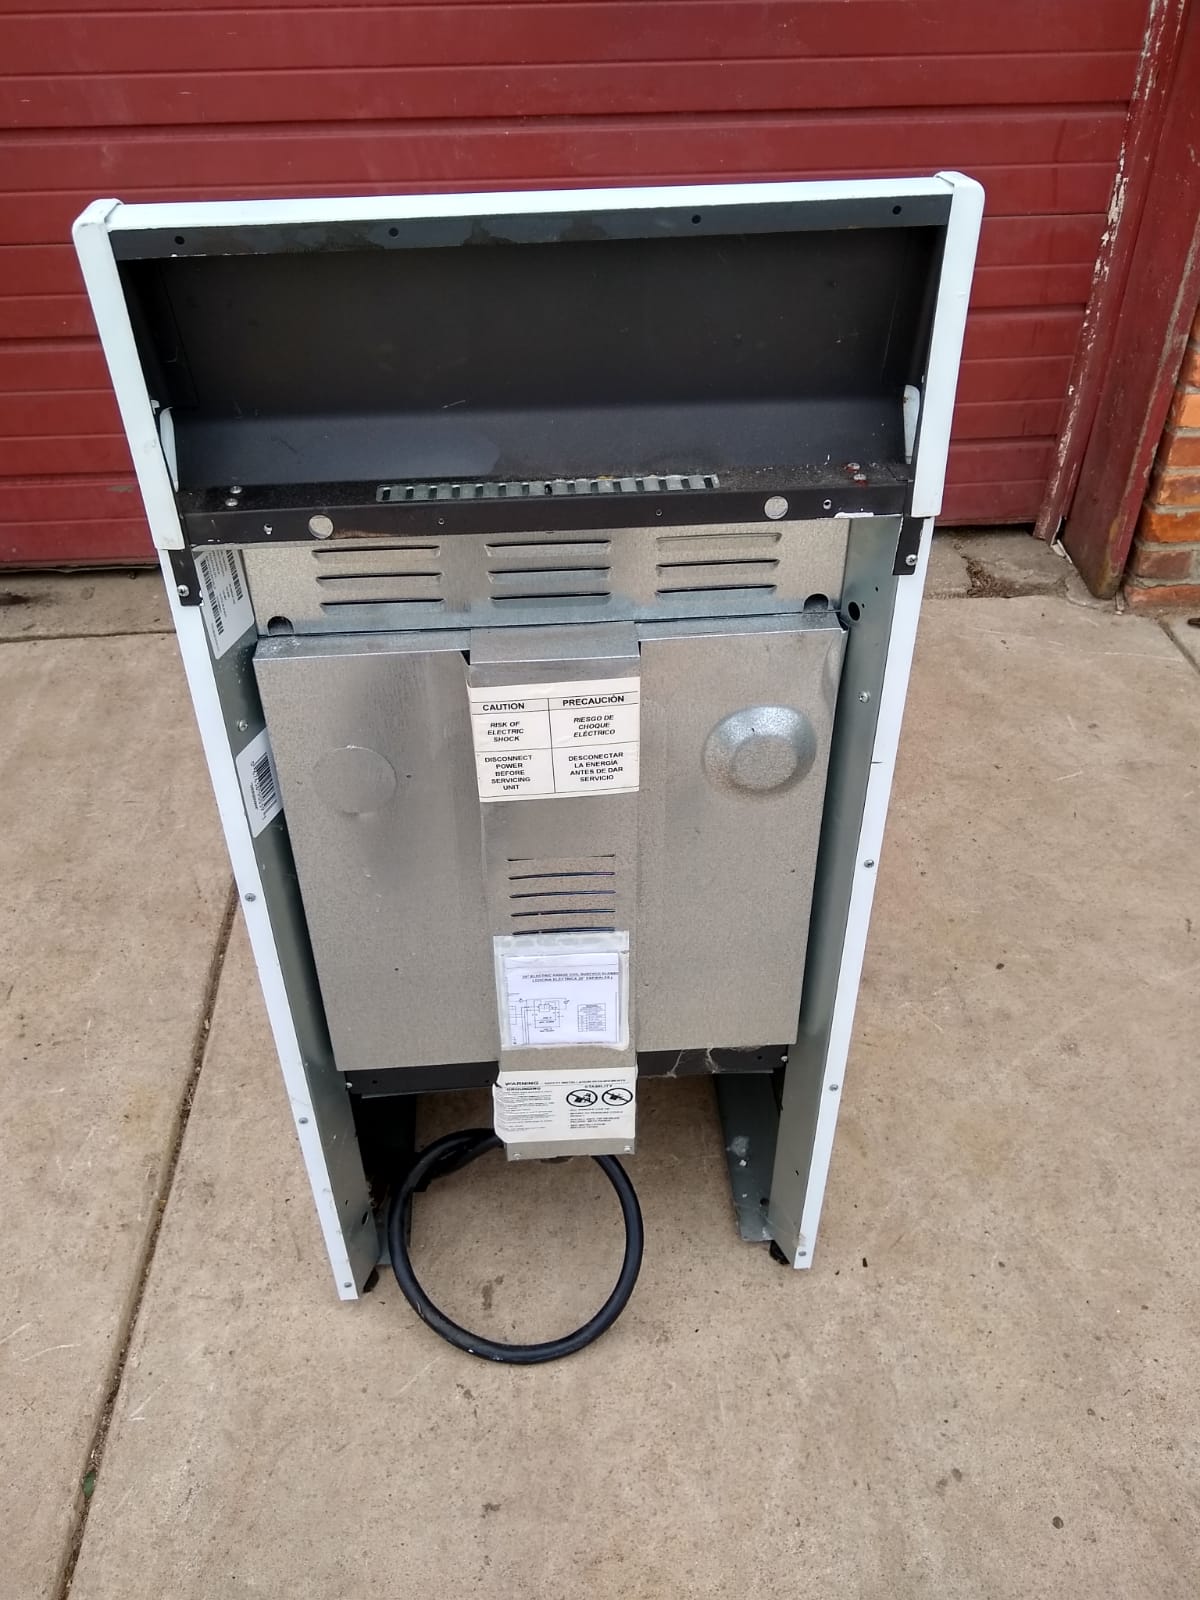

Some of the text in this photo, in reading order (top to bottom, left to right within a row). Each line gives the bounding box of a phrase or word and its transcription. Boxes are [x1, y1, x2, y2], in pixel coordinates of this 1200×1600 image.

[562, 695, 625, 707] PRECAUCIÓN
[482, 702, 525, 711] CAUTION
[578, 722, 610, 730] CHOQUE
[484, 754, 533, 762] DISCONNECT
[568, 752, 624, 762] DESCONECTAR
[495, 769, 525, 777] BEFORE
[570, 768, 595, 776] ANTES
[580, 774, 614, 782] SERVICIO
